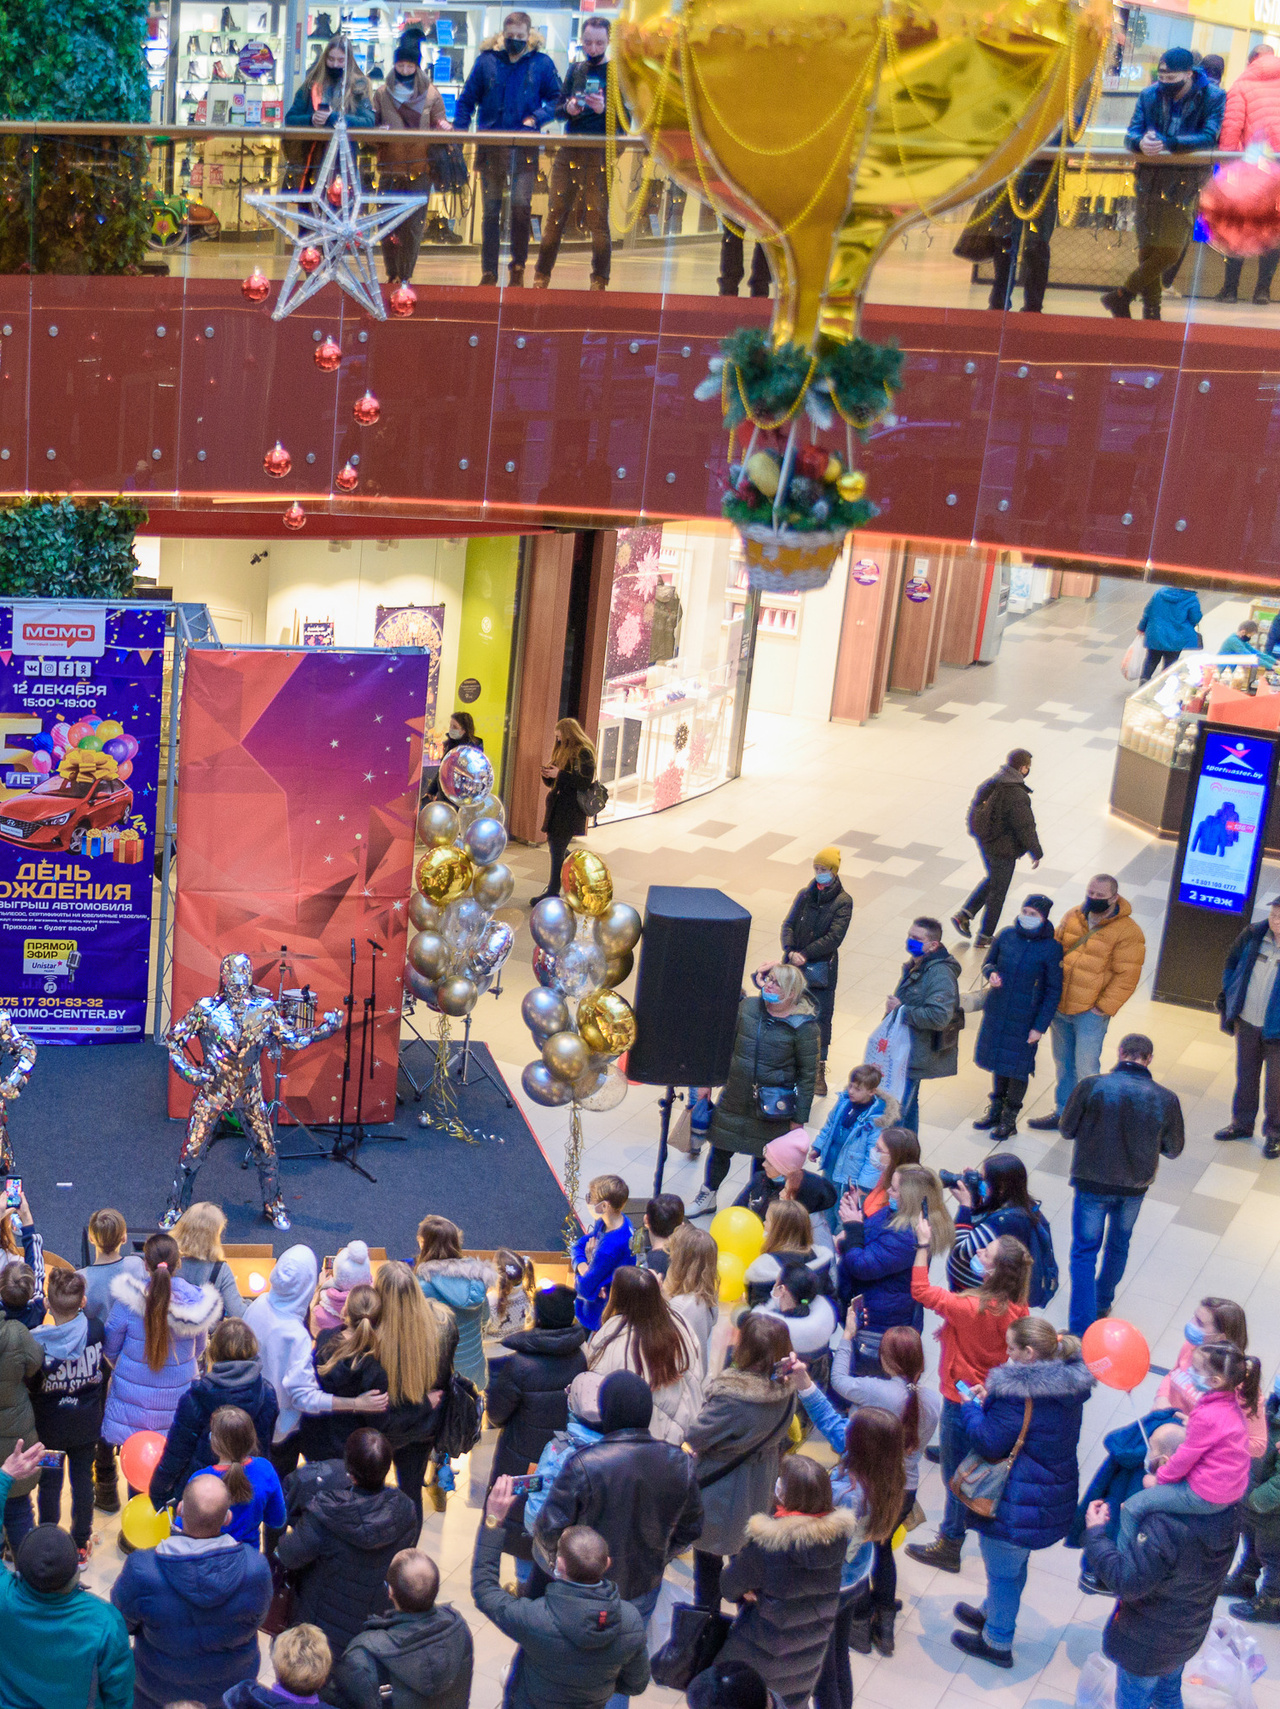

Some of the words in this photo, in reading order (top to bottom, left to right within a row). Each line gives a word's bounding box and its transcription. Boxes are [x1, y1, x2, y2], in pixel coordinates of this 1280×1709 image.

[26, 626, 92, 639] MOMO
[13, 684, 28, 695] 12
[31, 684, 107, 696] ДЕКАБРЯ
[8, 774, 42, 786] ЛЕТ
[15, 863, 91, 881] ДЕНЬ
[1188, 890, 1198, 900] 2
[1199, 894, 1234, 907] этаж
[51, 902, 133, 912] АВТОМОБИЛЯ
[2, 923, 37, 931] Приходи
[43, 924, 67, 932] будет
[68, 924, 98, 932] весело!
[27, 941, 74, 950] ПРЯМОЙ
[26, 950, 58, 959] ЭФИР
[31, 961, 57, 969] Unistar
[22, 997, 35, 1006] 17
[37, 997, 104, 1007] 301-63-32
